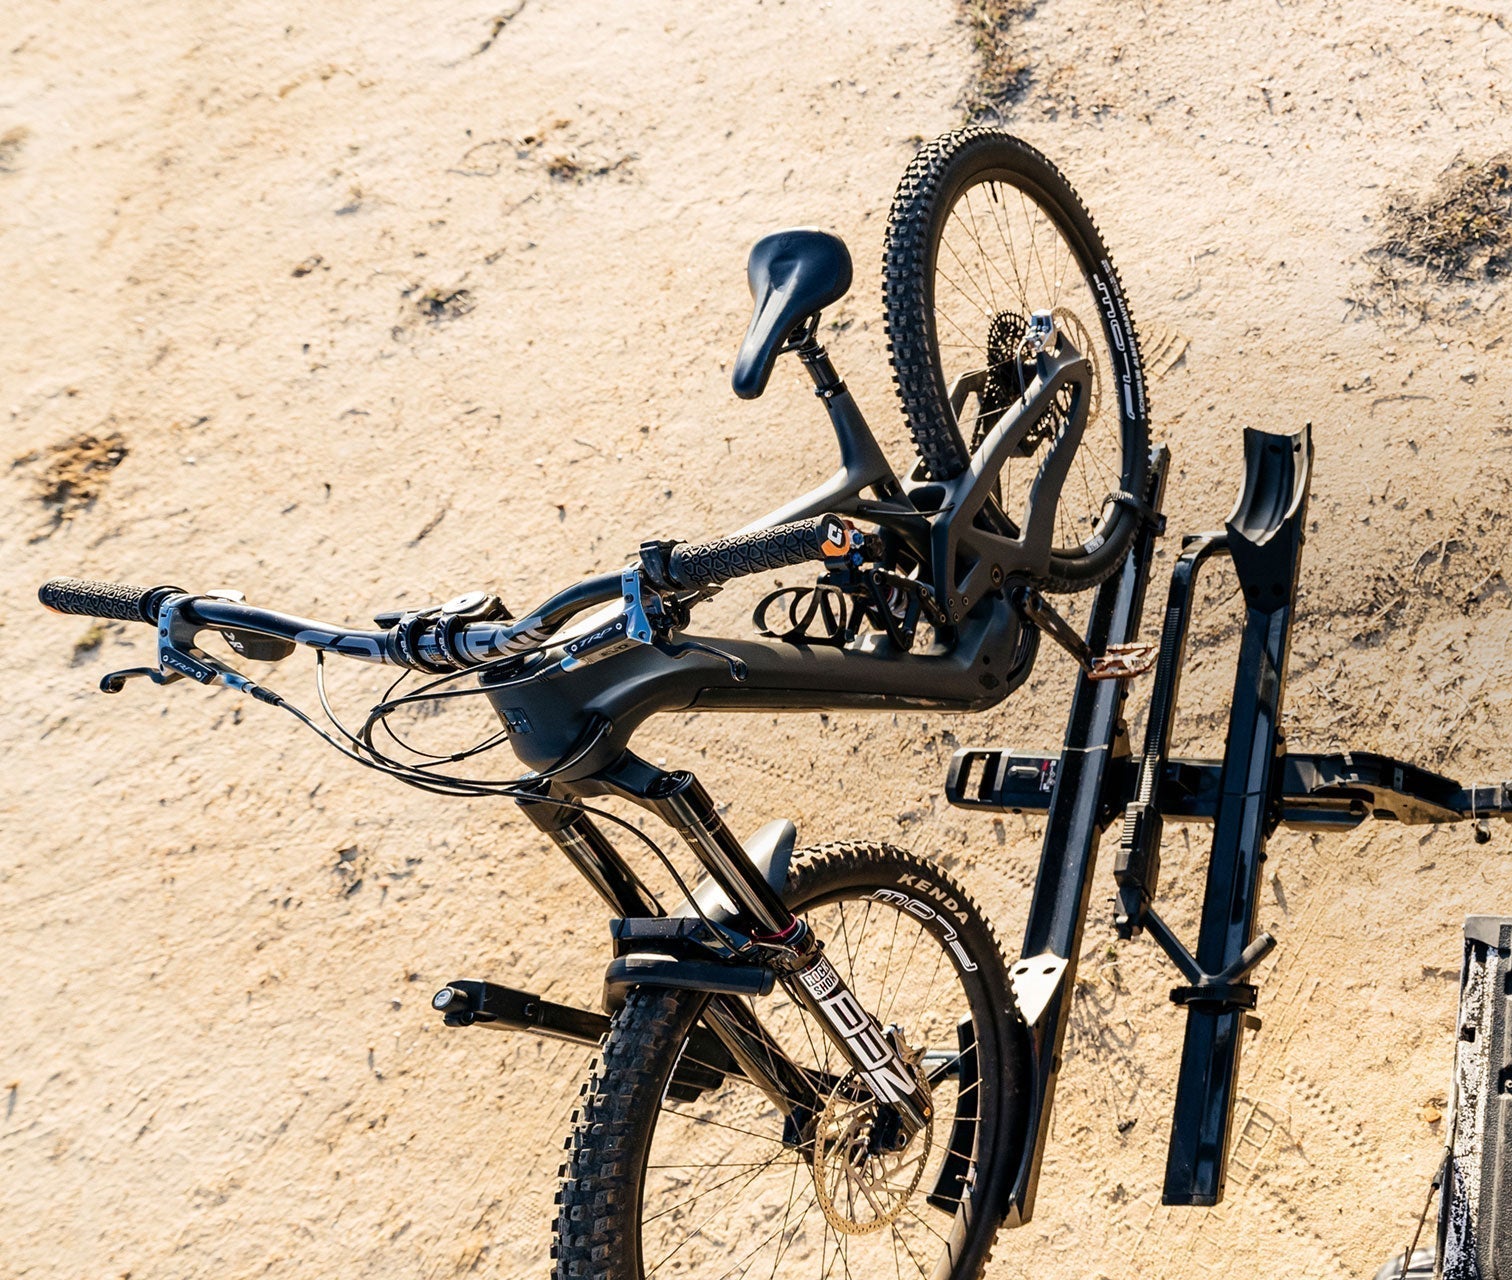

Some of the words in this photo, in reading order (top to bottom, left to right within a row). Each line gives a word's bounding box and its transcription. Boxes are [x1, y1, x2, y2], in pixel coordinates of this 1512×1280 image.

[1116, 297, 1133, 336] GRAVITY
[1128, 335, 1140, 369] ALBERT
[580, 626, 613, 648] TRP
[168, 656, 196, 674] TRP
[896, 872, 969, 925] KENDA
[803, 958, 831, 988] ROCK
[812, 972, 838, 997] SHOX
